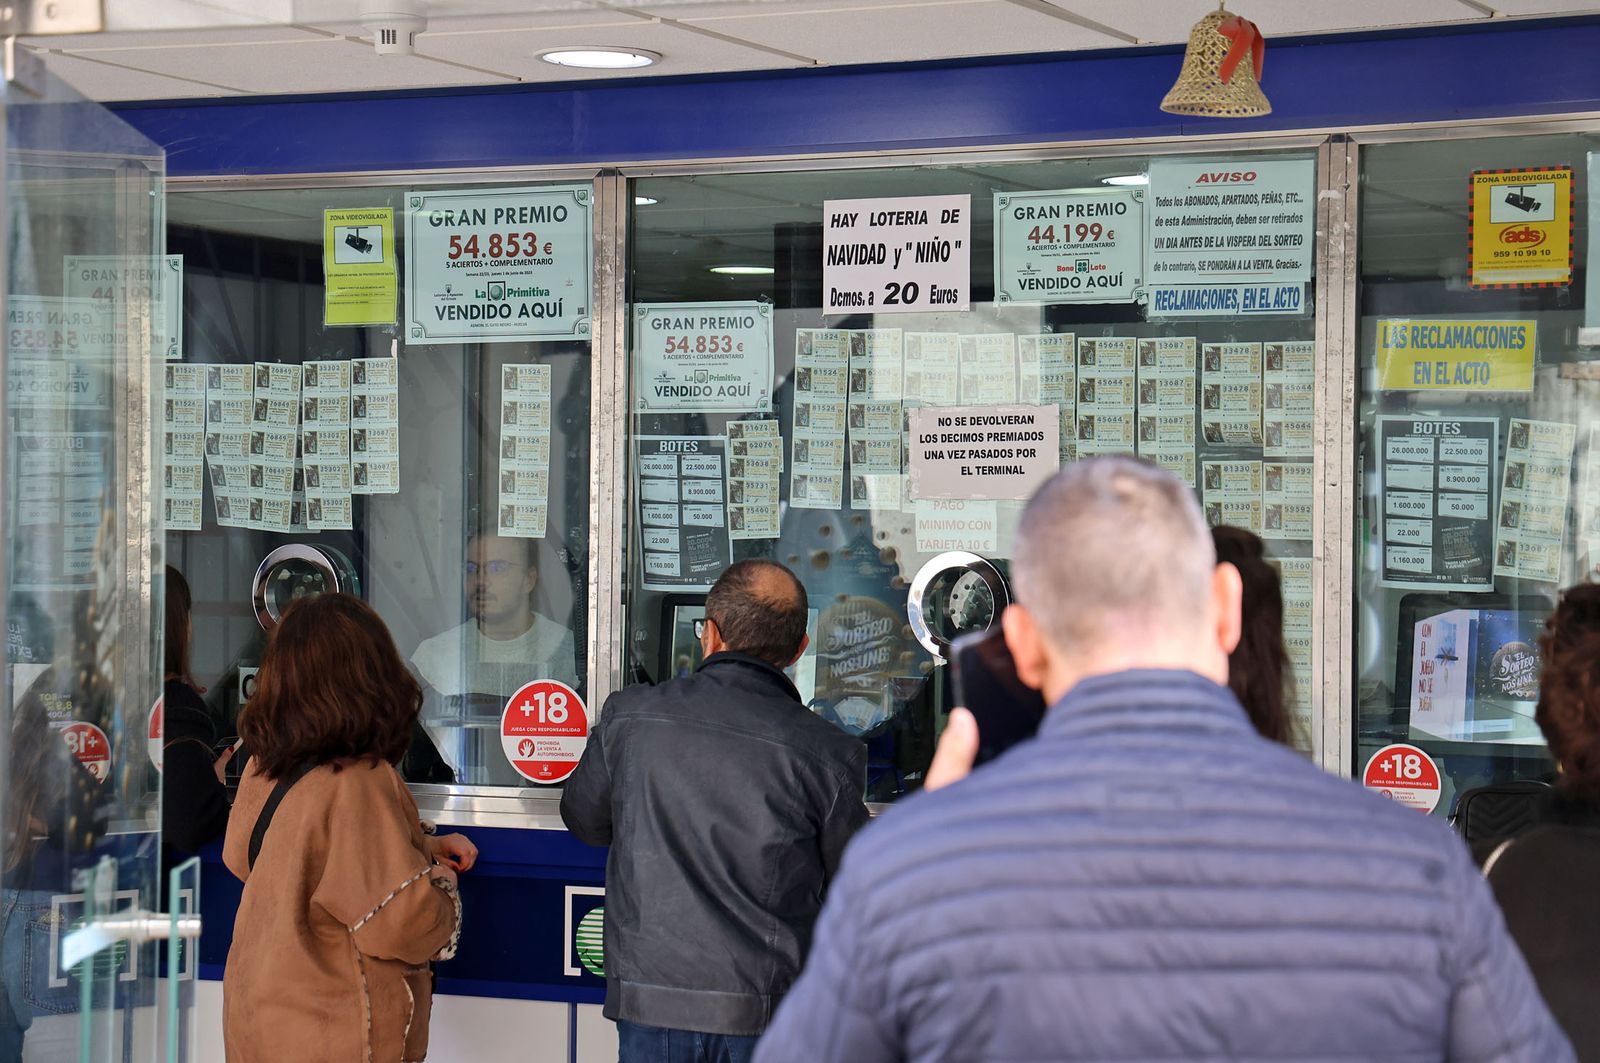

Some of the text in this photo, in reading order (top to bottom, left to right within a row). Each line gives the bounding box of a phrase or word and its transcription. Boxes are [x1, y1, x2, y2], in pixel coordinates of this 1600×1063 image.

[1196, 172, 1257, 183] AVISO
[1502, 173, 1568, 182] VIDEOVIGILADA
[1156, 197, 1172, 207] Todos
[1174, 196, 1183, 207] los
[1184, 195, 1220, 207] ABONADOS,
[1221, 193, 1260, 206] APARTADOS,
[1261, 191, 1282, 204] PEÑAS,
[429, 205, 568, 227] GRAN PREMIO
[1014, 202, 1126, 220] GRAN PREMIO
[830, 209, 960, 228] HAY LOTERIA DE
[1155, 213, 1303, 227] de esta Administración, deben ser retirados
[1028, 223, 1114, 244] 44.199 €
[1504, 226, 1541, 244] ads
[448, 232, 552, 259] 54.853 €
[1063, 242, 1115, 250] COMPLEMENTARIO
[1154, 234, 1303, 249] UN DIA ANTES DE LA VISPERA DEL SORTEO
[490, 258, 553, 267] COMPLEMENTARIO
[827, 243, 886, 266] NAVIDAD
[893, 248, 902, 270] y
[1154, 261, 1161, 272] de
[1162, 261, 1168, 271] lo
[1169, 261, 1196, 273] contrario,
[1198, 260, 1206, 271] SE
[1207, 258, 1236, 271] PONDRÁN
[1237, 260, 1242, 270] A
[1243, 259, 1251, 270] LA
[1252, 259, 1274, 270] VENTA.
[1018, 272, 1123, 290] VENDIDO AQUÍ
[475, 289, 486, 299] La
[507, 287, 550, 298] Primitiva
[868, 290, 874, 306] a
[883, 282, 919, 304] 20
[930, 285, 958, 304] Euros
[1154, 286, 1300, 314] RECLAMACIONES, EN EL ACTO
[435, 298, 563, 321] VENDIDO AQUÍ
[651, 316, 754, 330] GRAN PREMIO
[665, 335, 744, 353] 54.853 €
[1383, 325, 1526, 349] LAS RECLAMACIONES
[1414, 362, 1490, 385] EN EL ACTO
[654, 382, 751, 397] VENDIDO AQUÍ
[938, 415, 1034, 427] NO SE DEVOLVERAN
[1413, 422, 1461, 435] BOTES
[919, 431, 1044, 444] LOS DECIMOS PREMIADOS
[660, 441, 698, 452] BOTES
[1391, 447, 1429, 455] 26.000.000
[1444, 448, 1483, 456] 22.500.000
[924, 449, 1036, 460] UNA VEZ PASADOS POR
[961, 465, 1025, 475] EL TERMINAL
[1446, 476, 1480, 484] 8.900.000
[933, 501, 965, 510] PAGO
[1393, 502, 1426, 510] 1.600.000
[919, 520, 992, 530] MINIMO CON
[1397, 529, 1420, 537] 22.000
[919, 539, 990, 550] TARJETA 10 €
[1393, 557, 1424, 565] 1.160.000
[520, 691, 568, 724] +18
[1380, 754, 1421, 779] +18
